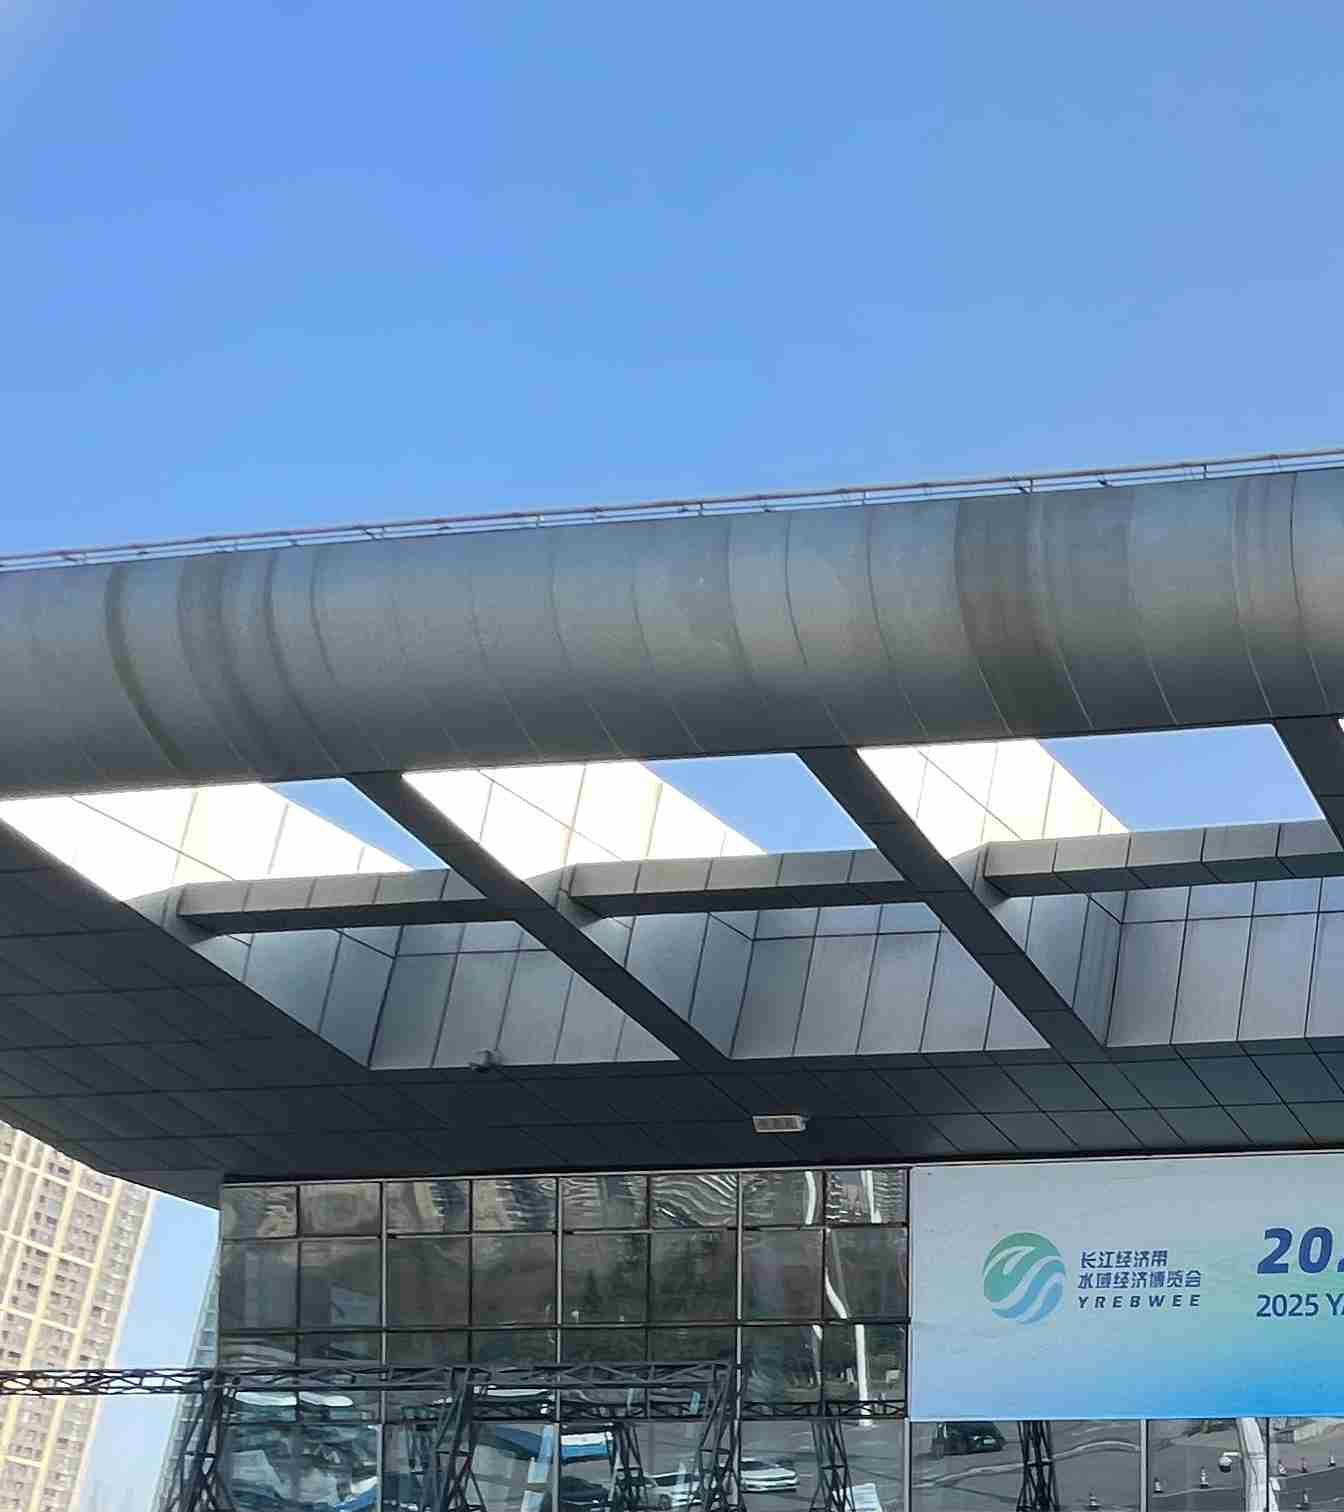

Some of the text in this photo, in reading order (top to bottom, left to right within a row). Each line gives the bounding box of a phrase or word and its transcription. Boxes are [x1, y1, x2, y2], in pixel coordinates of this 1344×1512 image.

[1080, 1250, 1168, 1269] 长江经济带
[1078, 1270, 1201, 1289] 水域经济博览会
[1078, 1294, 1201, 1309] YREBWEE
[1256, 1293, 1319, 1318] 2025
